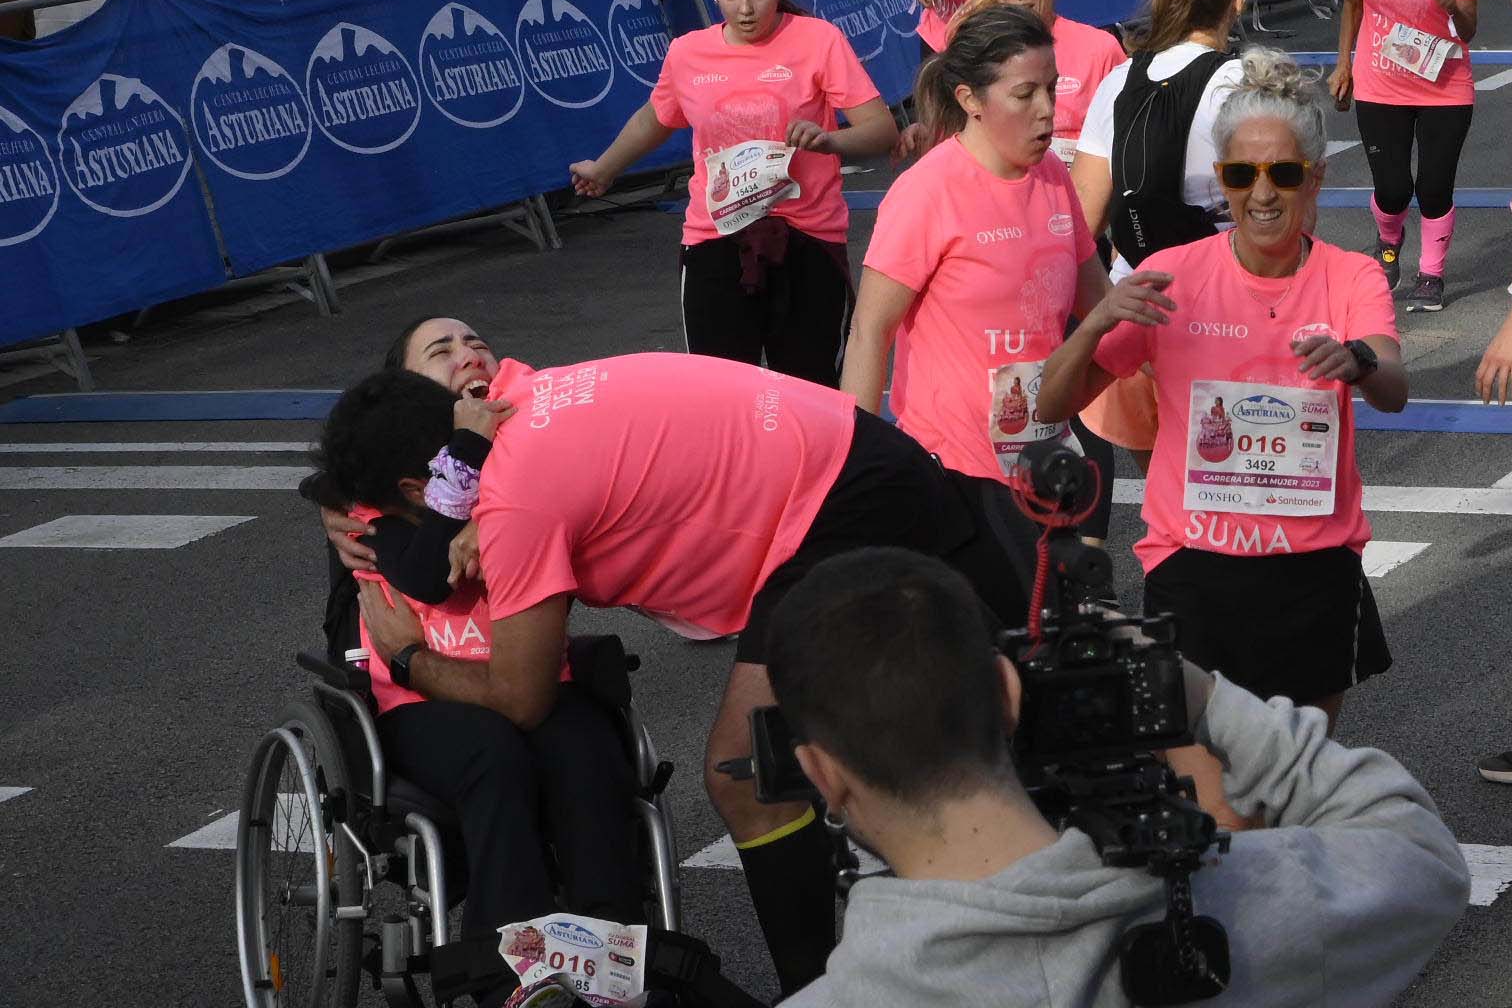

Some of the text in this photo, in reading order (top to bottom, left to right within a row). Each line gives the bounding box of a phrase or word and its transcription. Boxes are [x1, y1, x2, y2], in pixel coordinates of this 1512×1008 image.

[524, 38, 610, 84] ASTURIANA
[429, 54, 521, 102] ASTURIANA
[316, 77, 417, 128] ASTURIANA
[202, 100, 308, 153] ASTURIANA
[732, 167, 759, 188] 016
[736, 183, 759, 198] 15434
[976, 226, 1025, 244] OYSHO
[1129, 208, 1146, 248] EVADICT
[1189, 321, 1249, 339] OYSHO
[984, 329, 1026, 355] TU
[763, 389, 781, 433] OYSHO
[1236, 404, 1292, 420] ASTURIANA
[1301, 406, 1330, 415] SUMA
[1001, 444, 1025, 452] CARRE
[1237, 434, 1287, 453] 016
[1245, 459, 1276, 471] 3492
[1202, 474, 1322, 488] CARRERA DE LA MUJER 2023
[1198, 492, 1324, 508] OYSHO Santander
[1184, 511, 1294, 554] SUMA
[426, 616, 486, 653] MA
[608, 937, 635, 949] SUMA
[550, 951, 597, 977] 016
